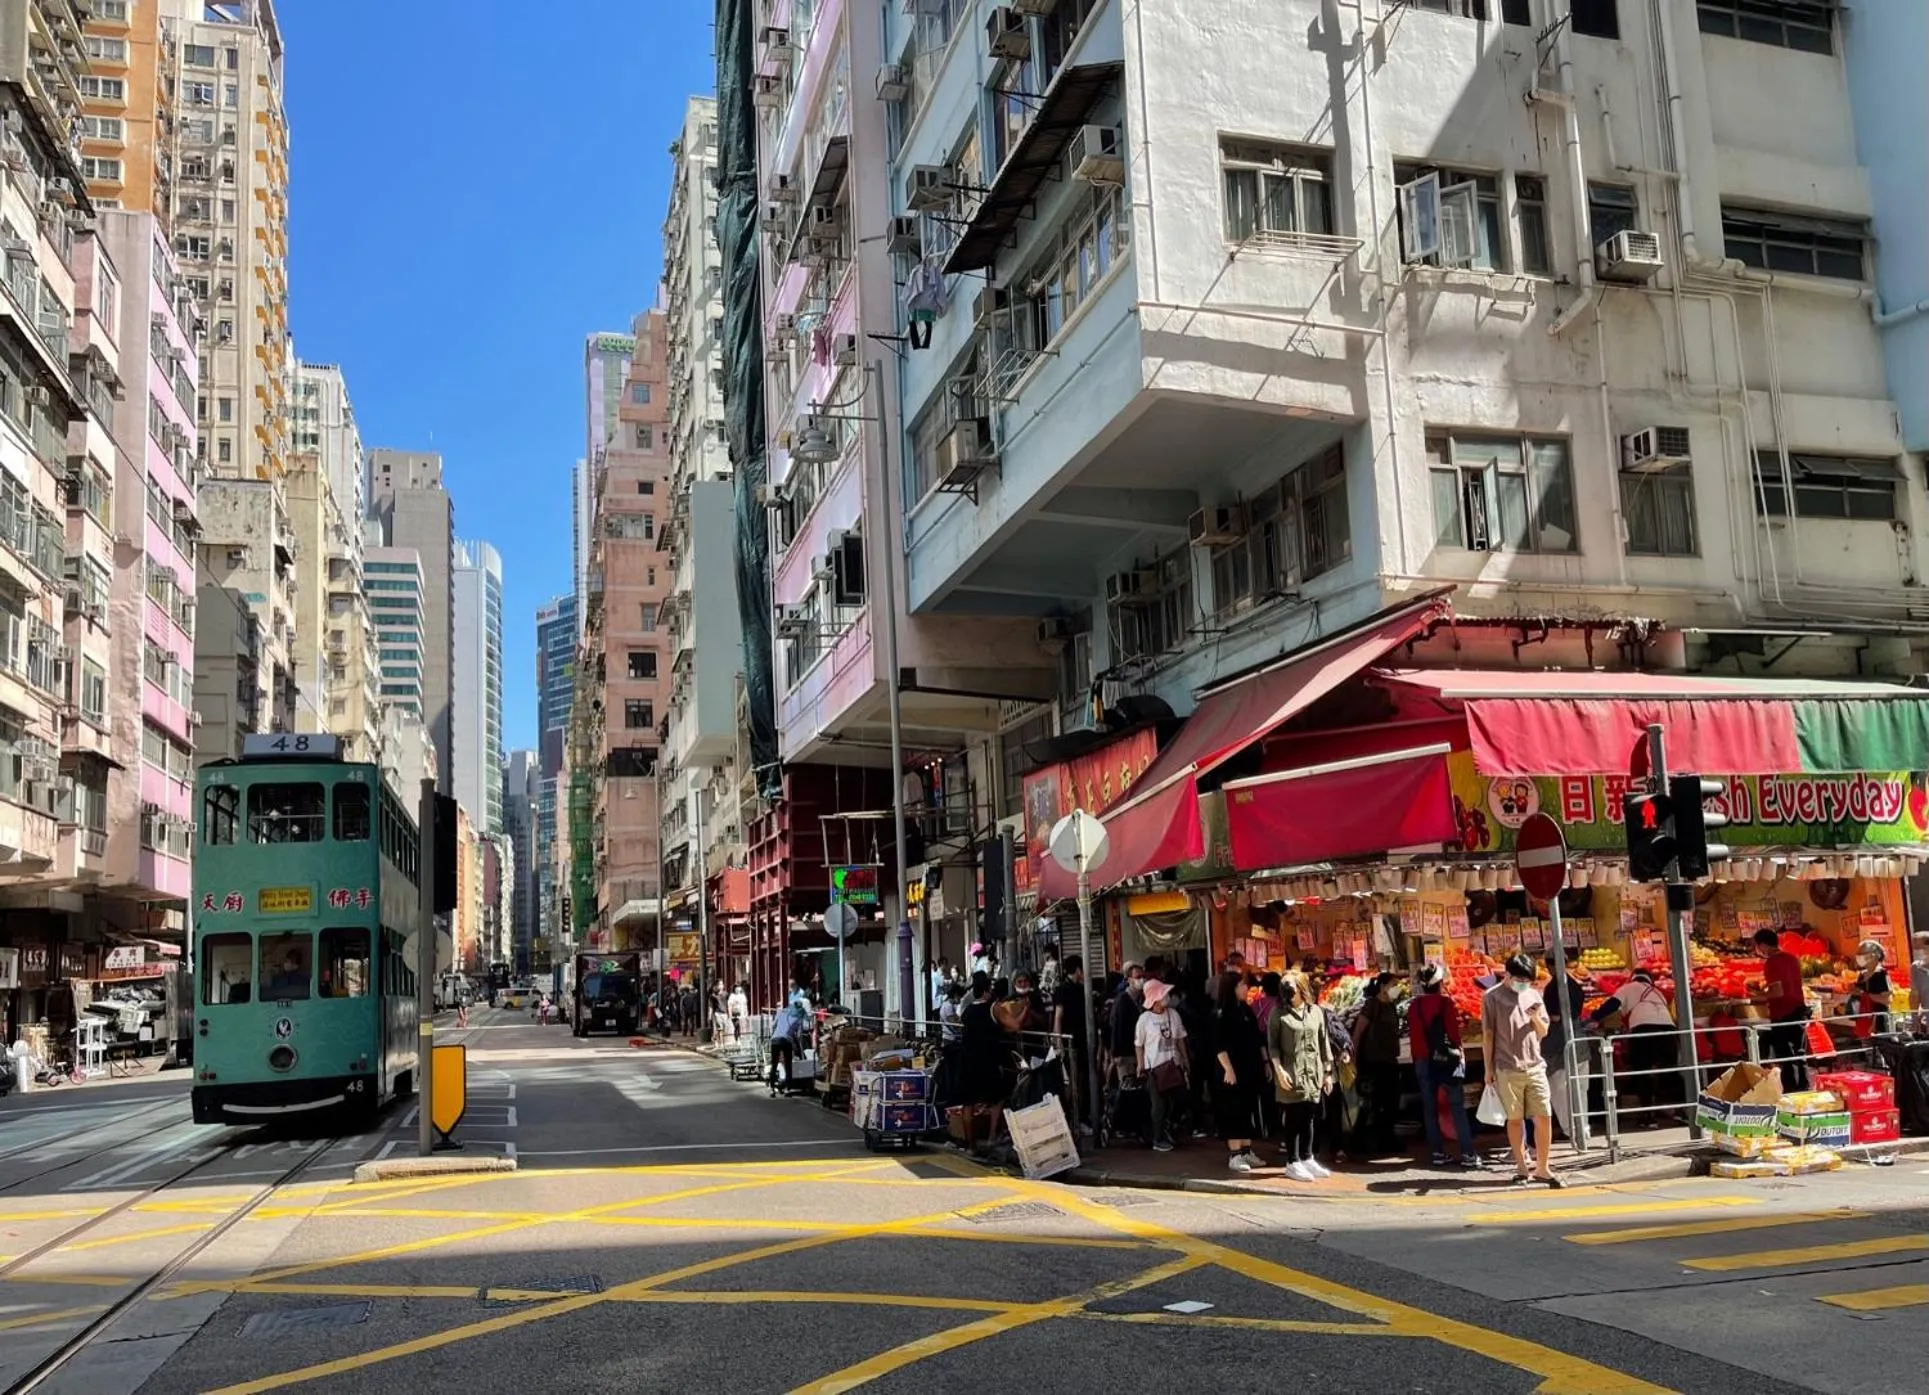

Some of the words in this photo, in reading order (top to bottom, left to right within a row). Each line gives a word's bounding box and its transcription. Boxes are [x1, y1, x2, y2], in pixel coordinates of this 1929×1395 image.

[271, 735, 309, 751] 48
[208, 771, 225, 784] 48
[347, 770, 364, 782] 48
[1757, 771, 1903, 823] Everyday
[328, 888, 377, 909] 佛手
[346, 1079, 364, 1092] 48
